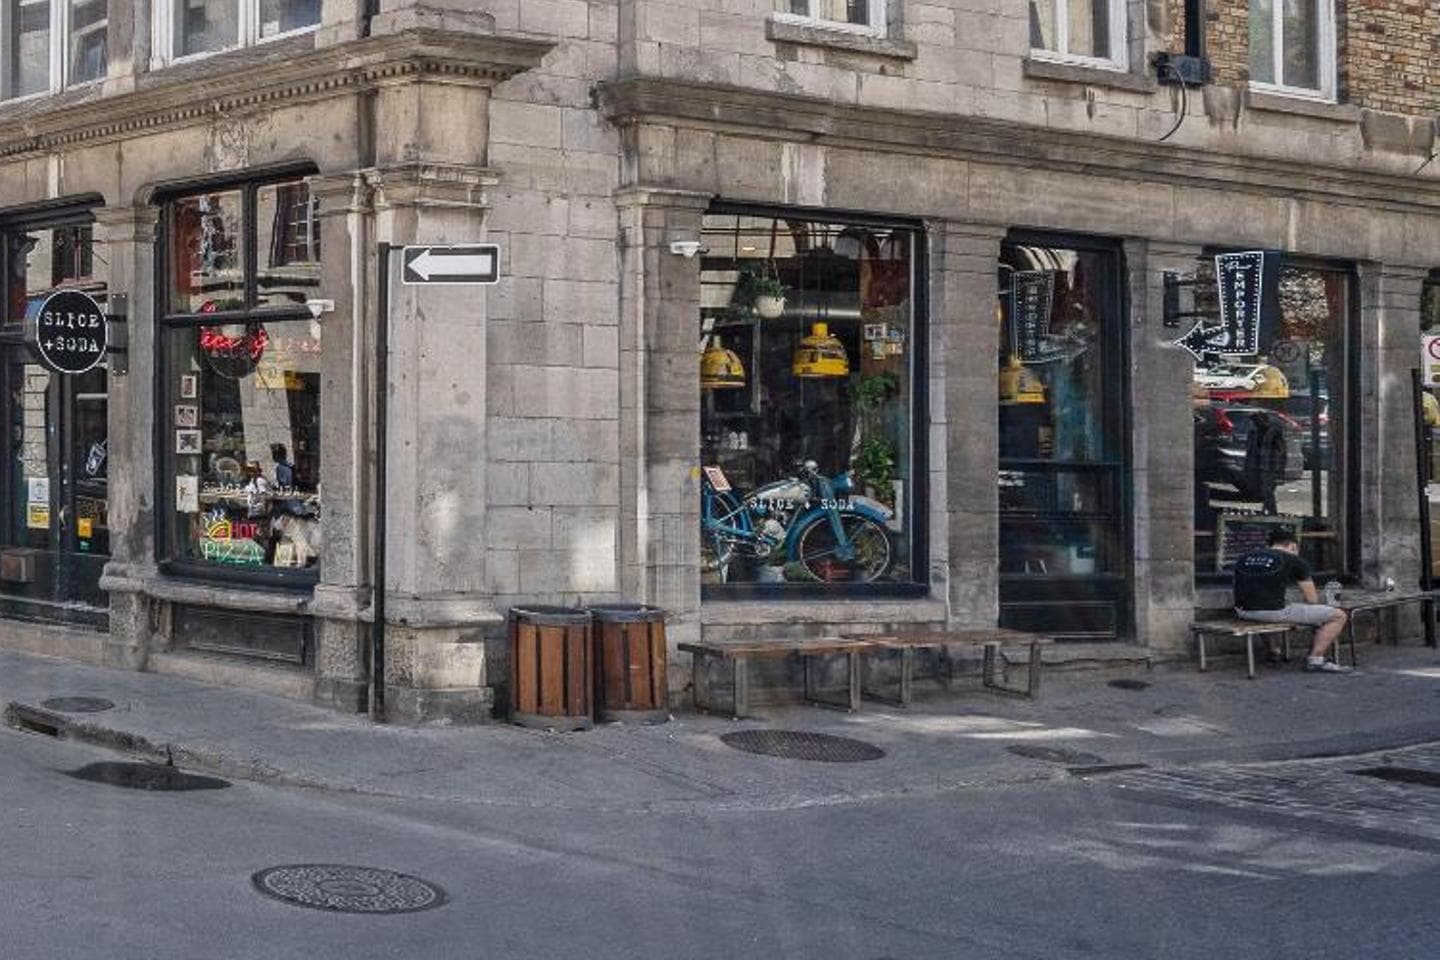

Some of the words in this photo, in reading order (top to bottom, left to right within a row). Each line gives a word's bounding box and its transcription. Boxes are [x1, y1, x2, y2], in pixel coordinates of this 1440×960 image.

[1233, 271, 1246, 348] EMPORTER
[44, 311, 100, 329] SLICE
[820, 498, 855, 511] SODA
[230, 521, 259, 539] HOT
[203, 540, 263, 566] PIZZA
